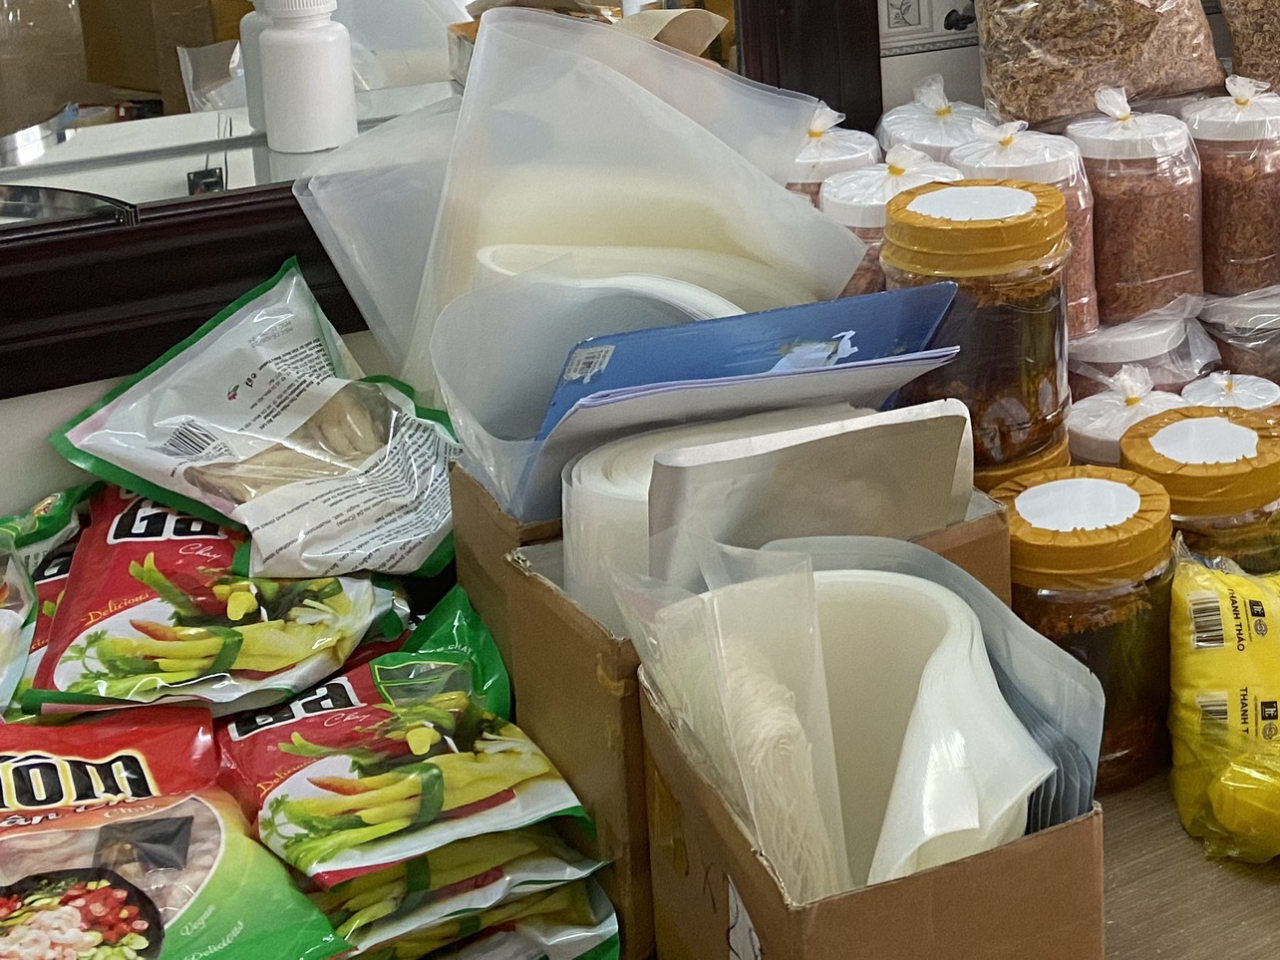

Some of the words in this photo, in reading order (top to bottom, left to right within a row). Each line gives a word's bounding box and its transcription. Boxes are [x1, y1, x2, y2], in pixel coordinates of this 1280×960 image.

[178, 543, 222, 562] Chay
[81, 592, 150, 628] Delicious
[1240, 686, 1249, 729] THANH
[180, 904, 216, 936] Vegan
